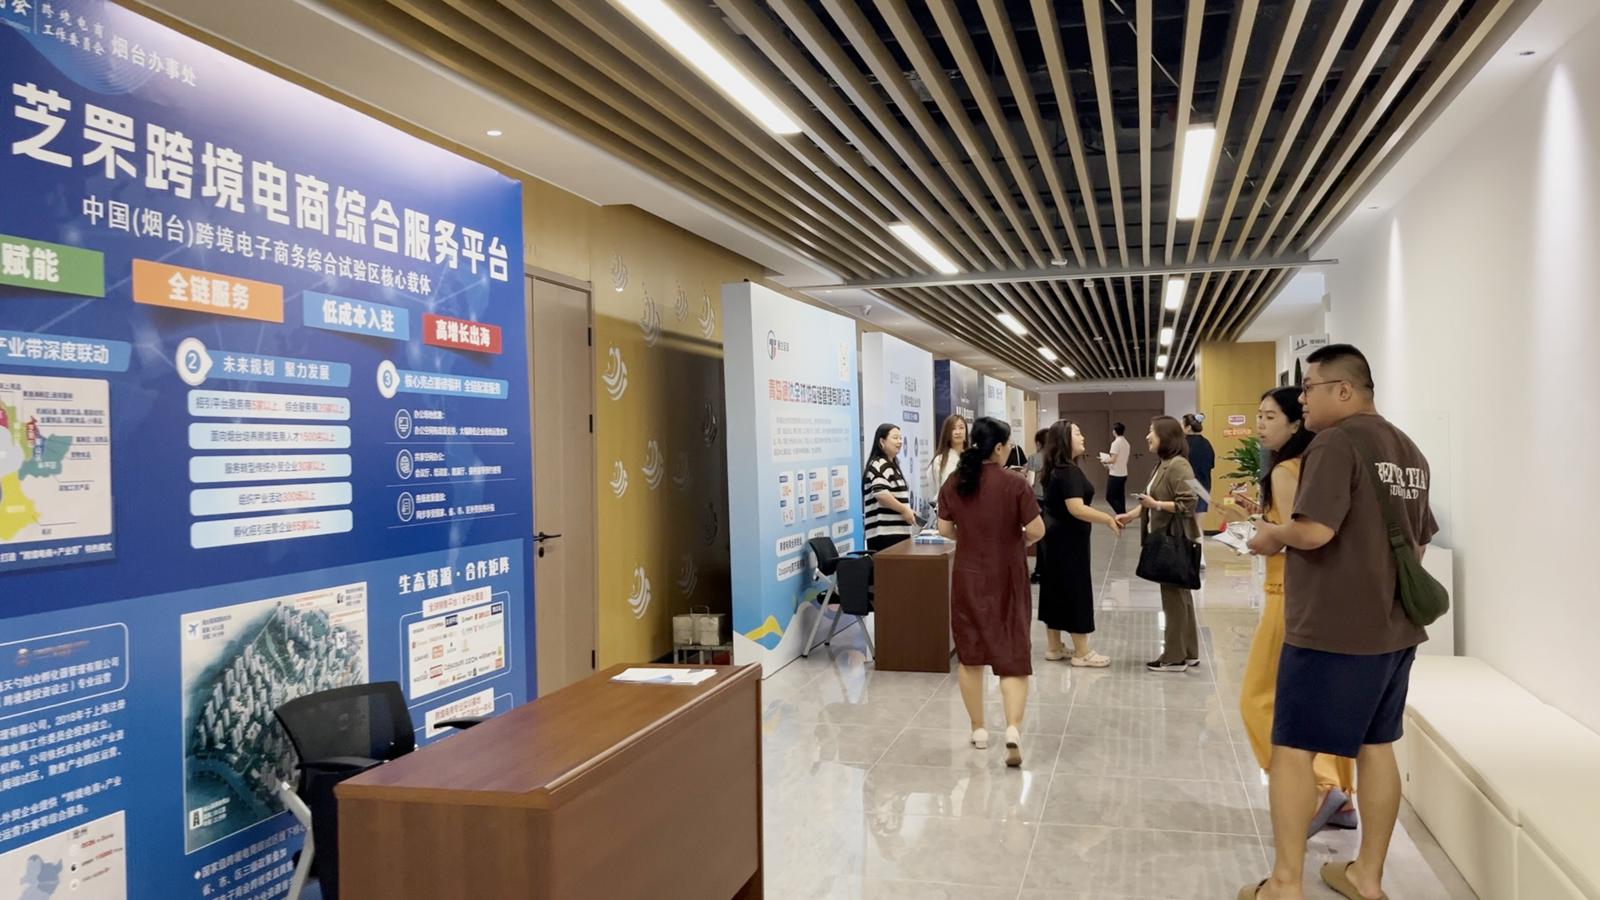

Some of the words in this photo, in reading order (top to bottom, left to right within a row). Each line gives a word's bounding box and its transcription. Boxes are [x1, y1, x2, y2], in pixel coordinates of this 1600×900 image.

[0, 0, 32, 16] 会
[42, 24, 104, 56] 工作委员会
[111, 36, 197, 87] 烟台办事处
[12, 82, 509, 282] 芝罘跨境电商综合服务平台
[168, 271, 249, 310] 全链服务
[321, 298, 395, 333] 低成本入驻
[435, 319, 491, 348] 高增长出海
[187, 352, 197, 370] 2
[223, 355, 275, 377] 未来规划
[284, 360, 331, 381] 聚力发展
[384, 372, 391, 386] 3
